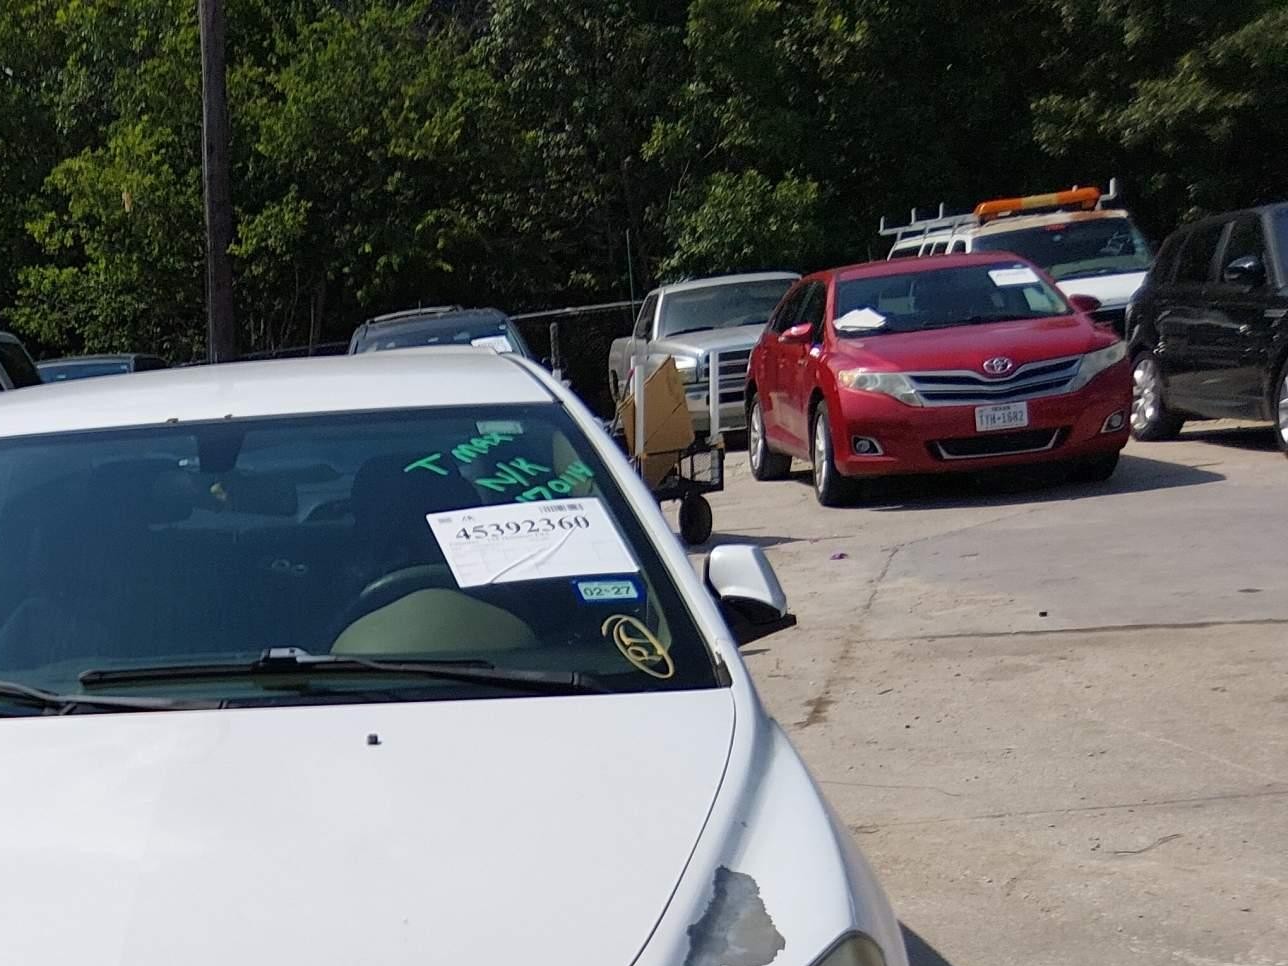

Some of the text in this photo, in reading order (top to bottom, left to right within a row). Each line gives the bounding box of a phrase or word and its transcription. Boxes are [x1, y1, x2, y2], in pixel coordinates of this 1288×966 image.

[404, 453, 449, 476] T
[455, 514, 590, 541] 45392360
[582, 585, 631, 597] 02-27
